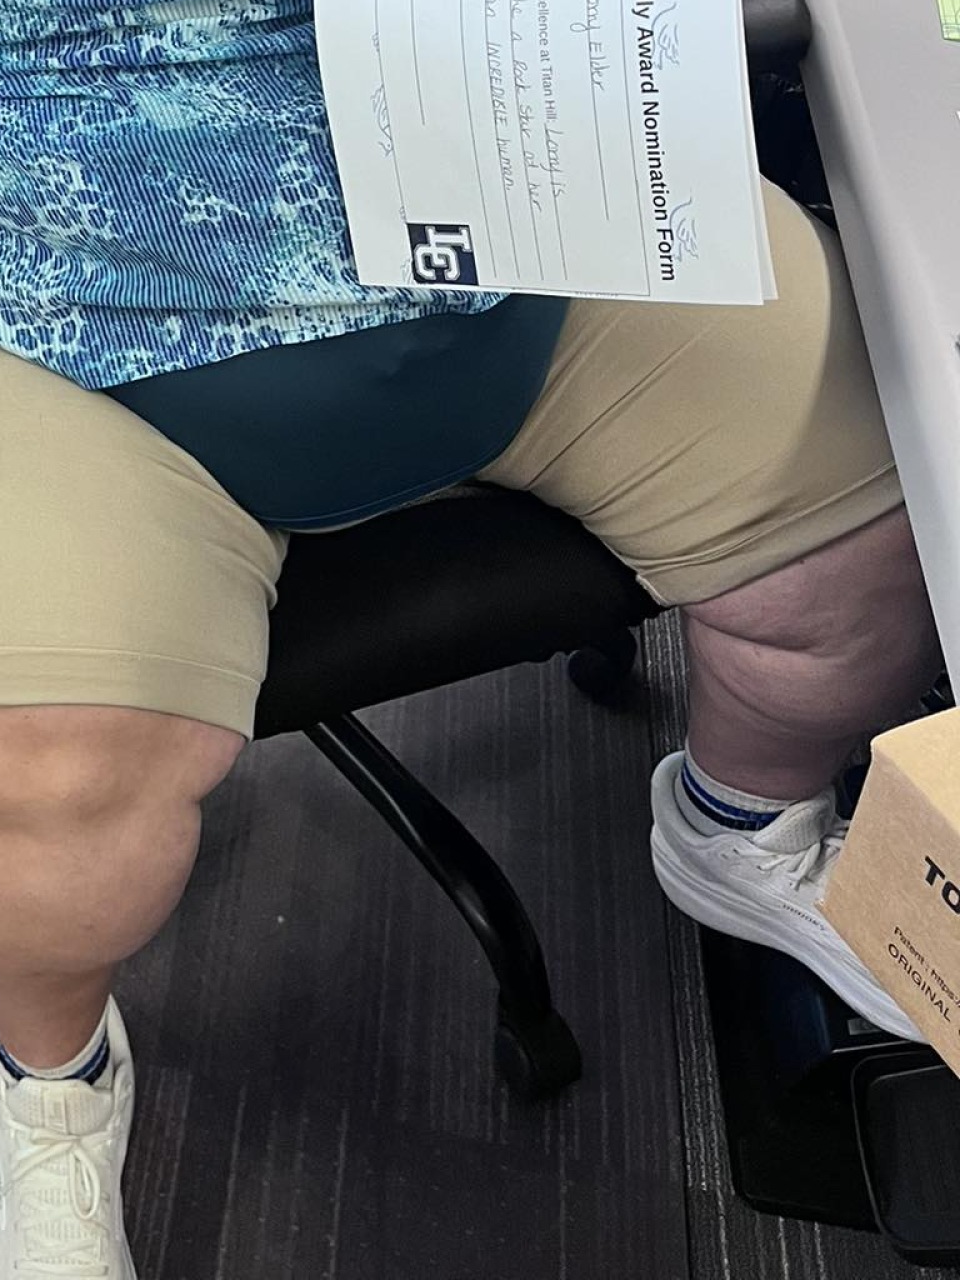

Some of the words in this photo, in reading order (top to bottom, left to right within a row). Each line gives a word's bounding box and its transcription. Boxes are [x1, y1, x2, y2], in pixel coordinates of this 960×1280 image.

[511, 31, 524, 43] a
[540, 49, 551, 62] at
[590, 41, 609, 91] Elder
[637, 26, 659, 94] Award
[487, 41, 508, 127] INCREDIBLE
[542, 64, 556, 97] Titan
[544, 100, 557, 123] Hill:
[524, 151, 539, 168] at
[641, 101, 670, 221] Nomination
[529, 183, 543, 212] her
[551, 181, 565, 198] is
[656, 228, 676, 282] Form
[894, 926, 925, 966] Patent
[887, 943, 952, 1023] ORIGINAL
